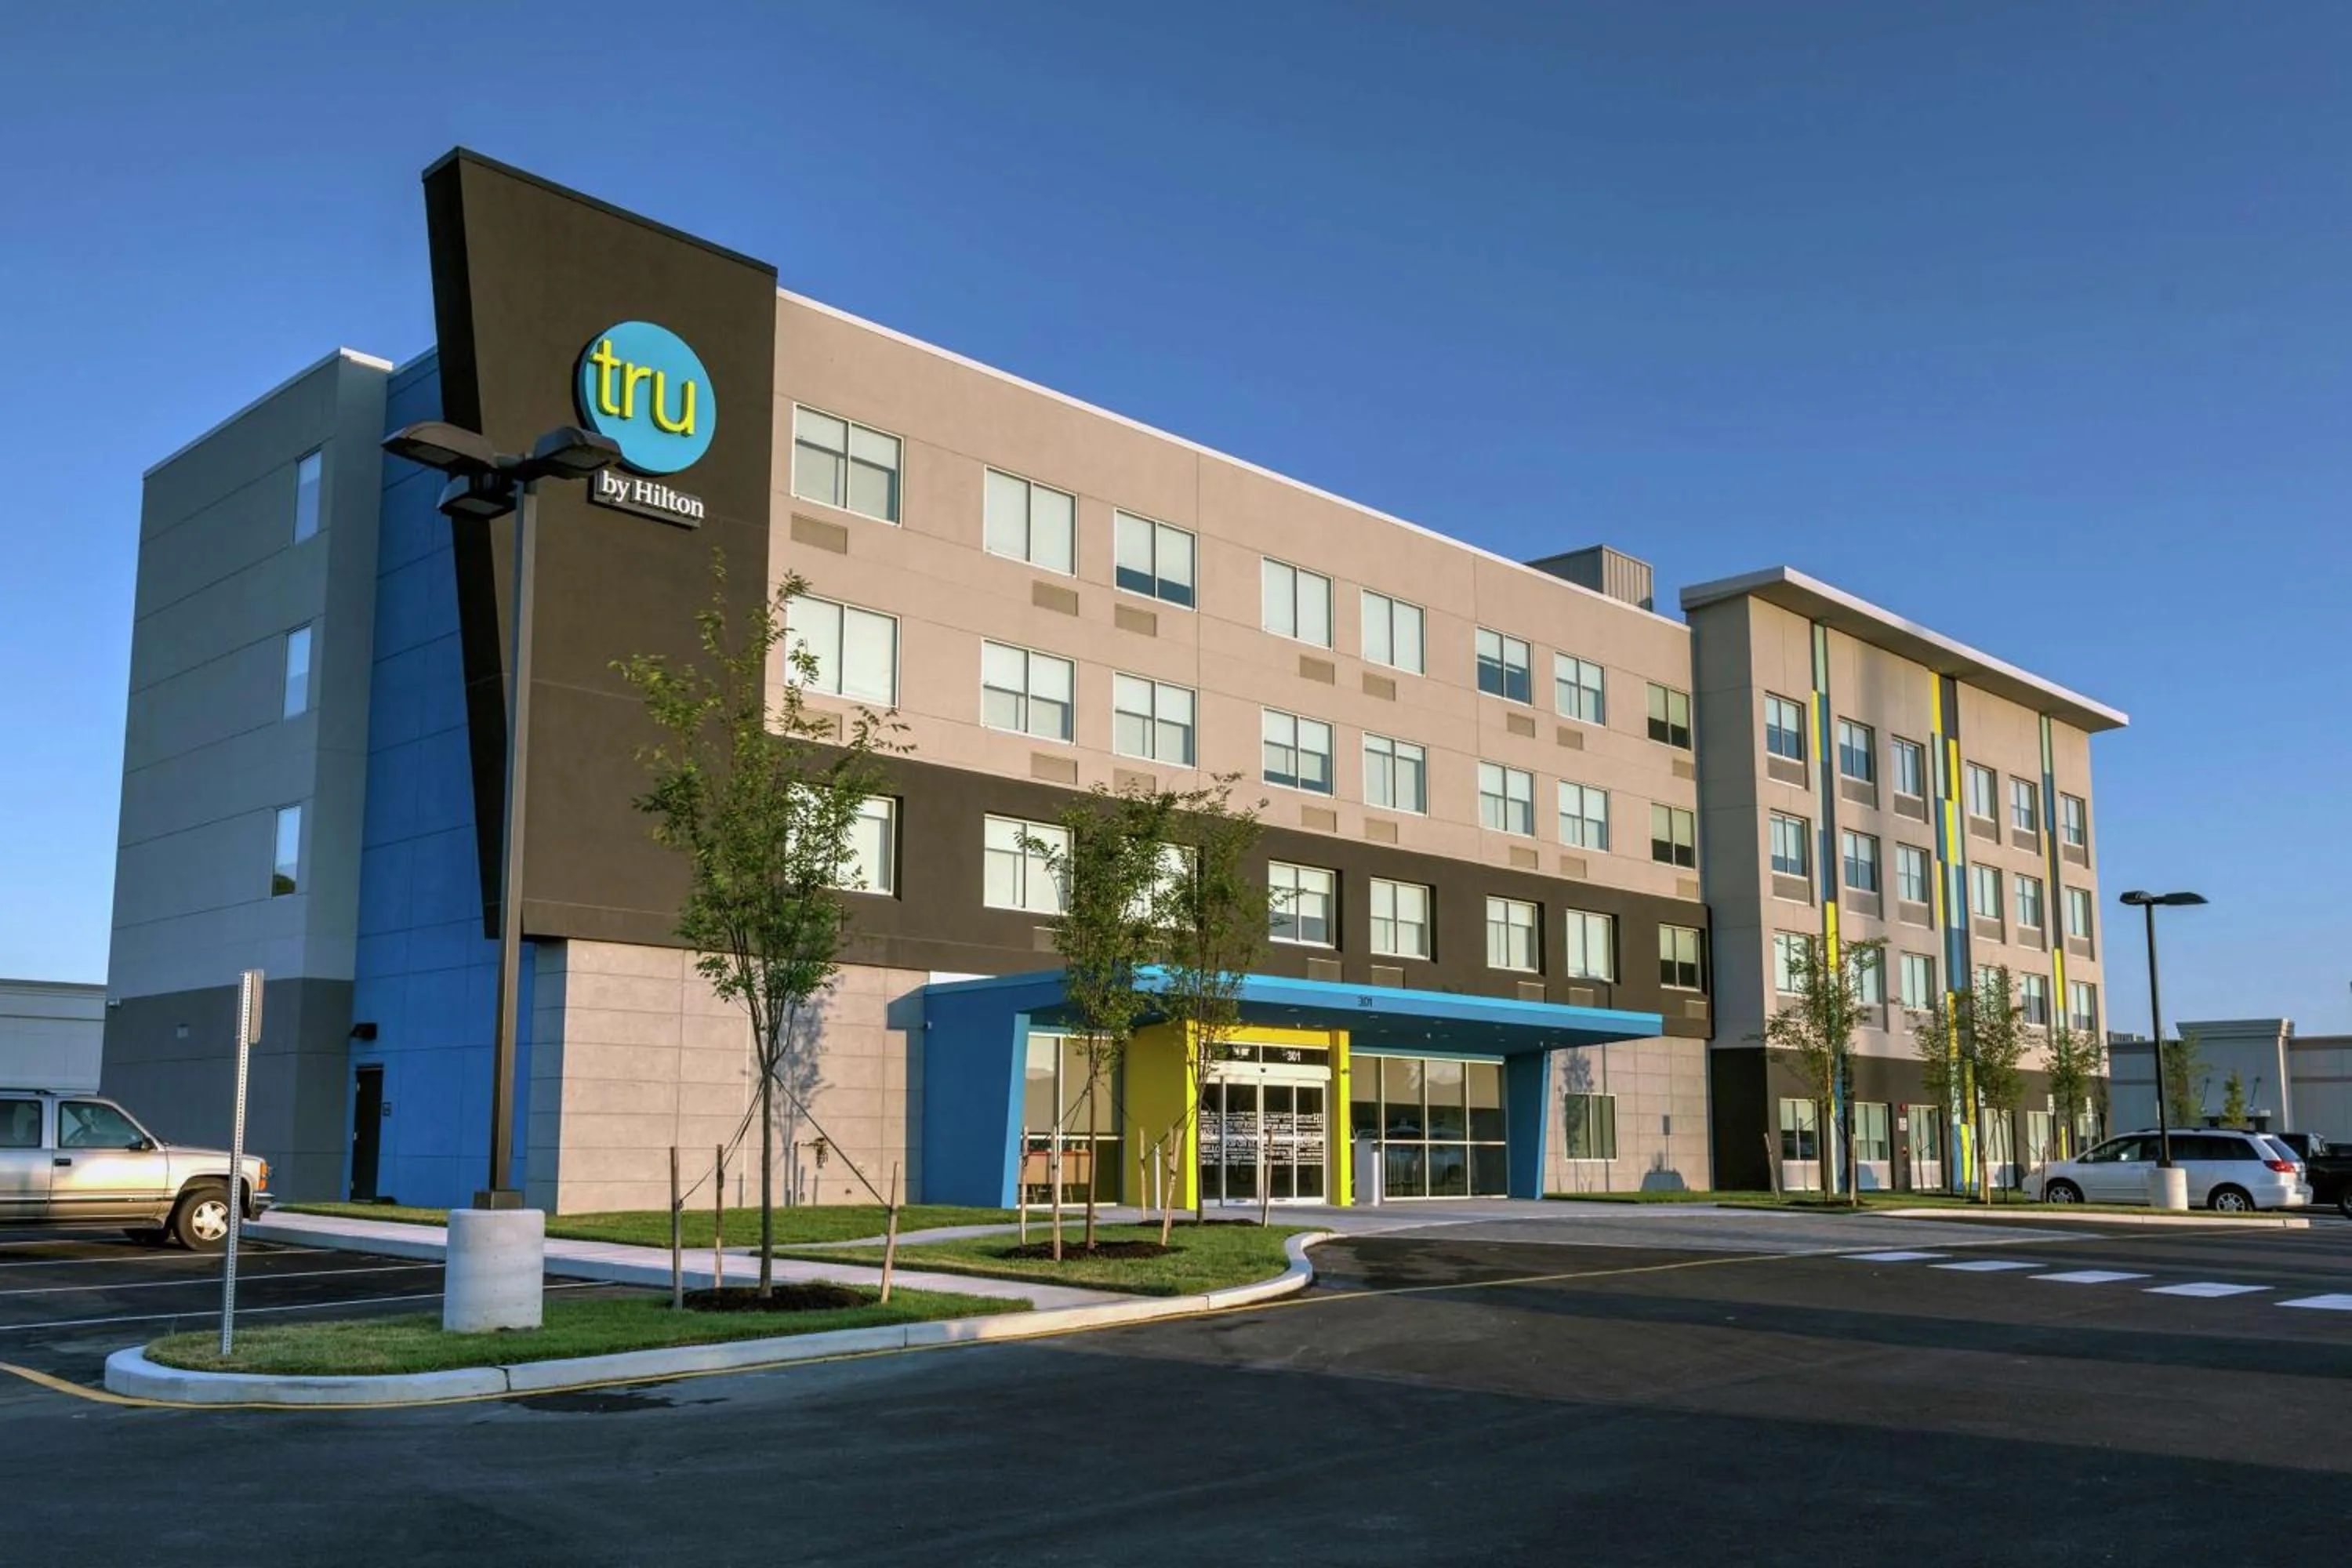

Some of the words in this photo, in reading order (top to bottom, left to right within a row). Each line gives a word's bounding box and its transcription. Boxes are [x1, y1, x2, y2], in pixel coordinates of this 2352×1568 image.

[590, 339, 695, 436] tru
[602, 470, 630, 502] by
[634, 480, 704, 518] Hilton
[1357, 996, 1372, 1007] 301
[1287, 1051, 1301, 1062] 301
